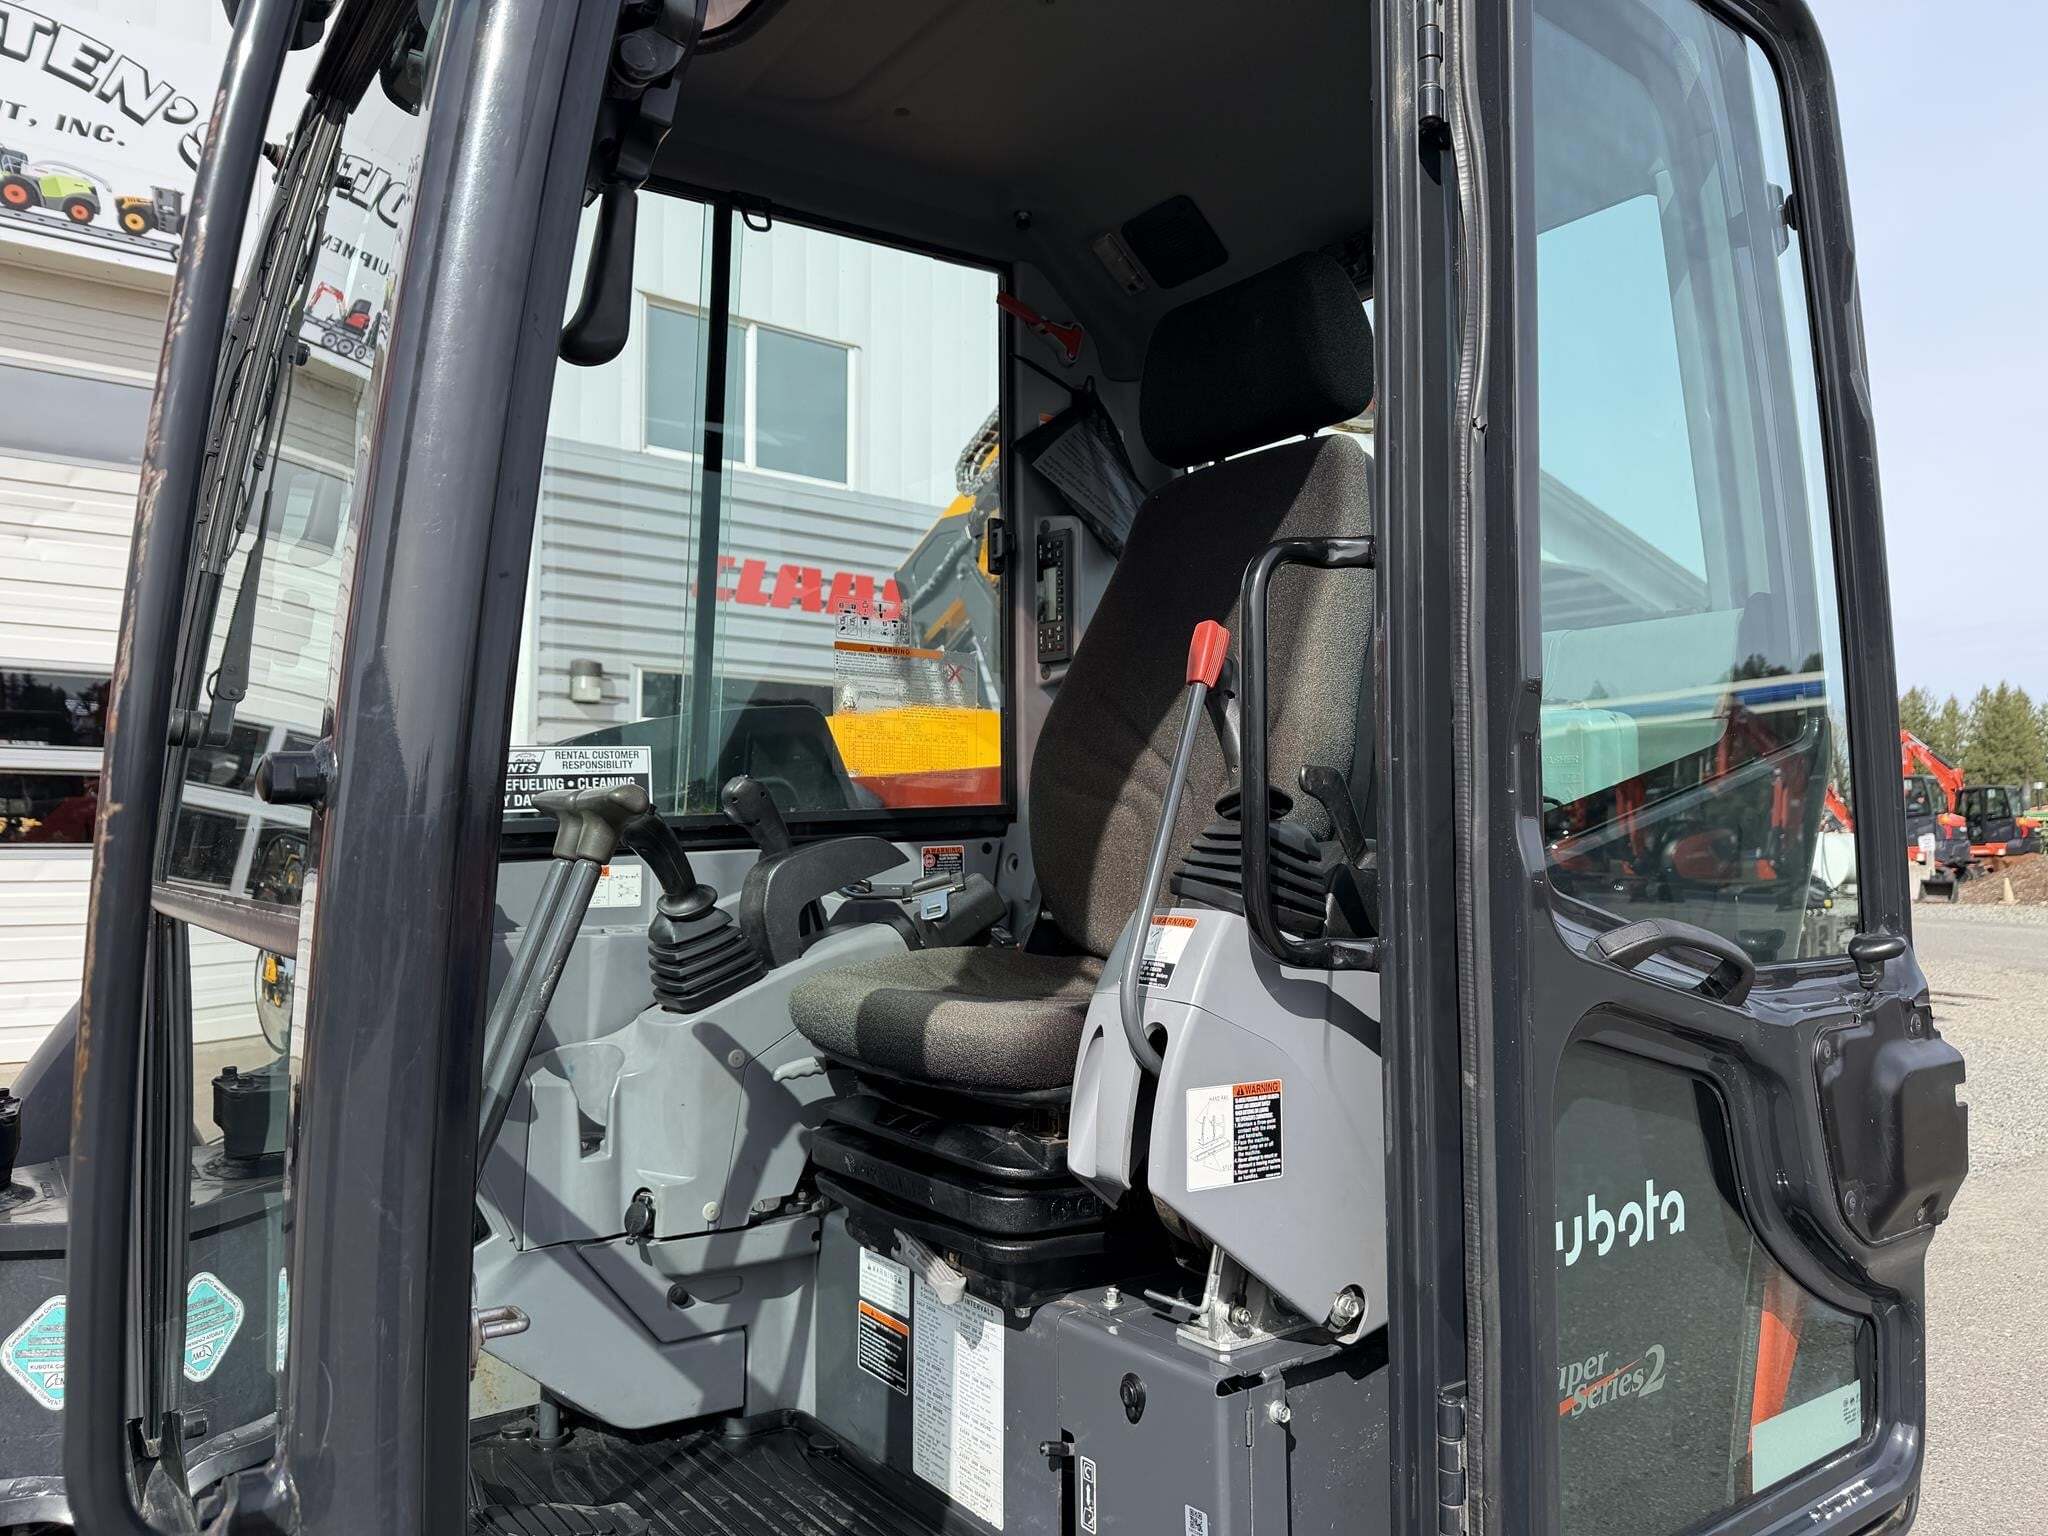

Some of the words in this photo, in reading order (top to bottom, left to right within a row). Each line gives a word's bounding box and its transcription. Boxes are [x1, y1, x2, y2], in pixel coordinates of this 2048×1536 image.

[55, 113, 126, 146] INC.
[877, 646, 911, 655] WARNING
[555, 751, 590, 760] RENTAL
[592, 751, 640, 759] CUSTOMER
[562, 760, 633, 769] RESPONSIBILITY
[505, 778, 565, 791] EFUELING
[1245, 1082, 1278, 1095] WARNING
[1556, 1179, 1685, 1266] ubota
[964, 1296, 994, 1317] INTERVALS
